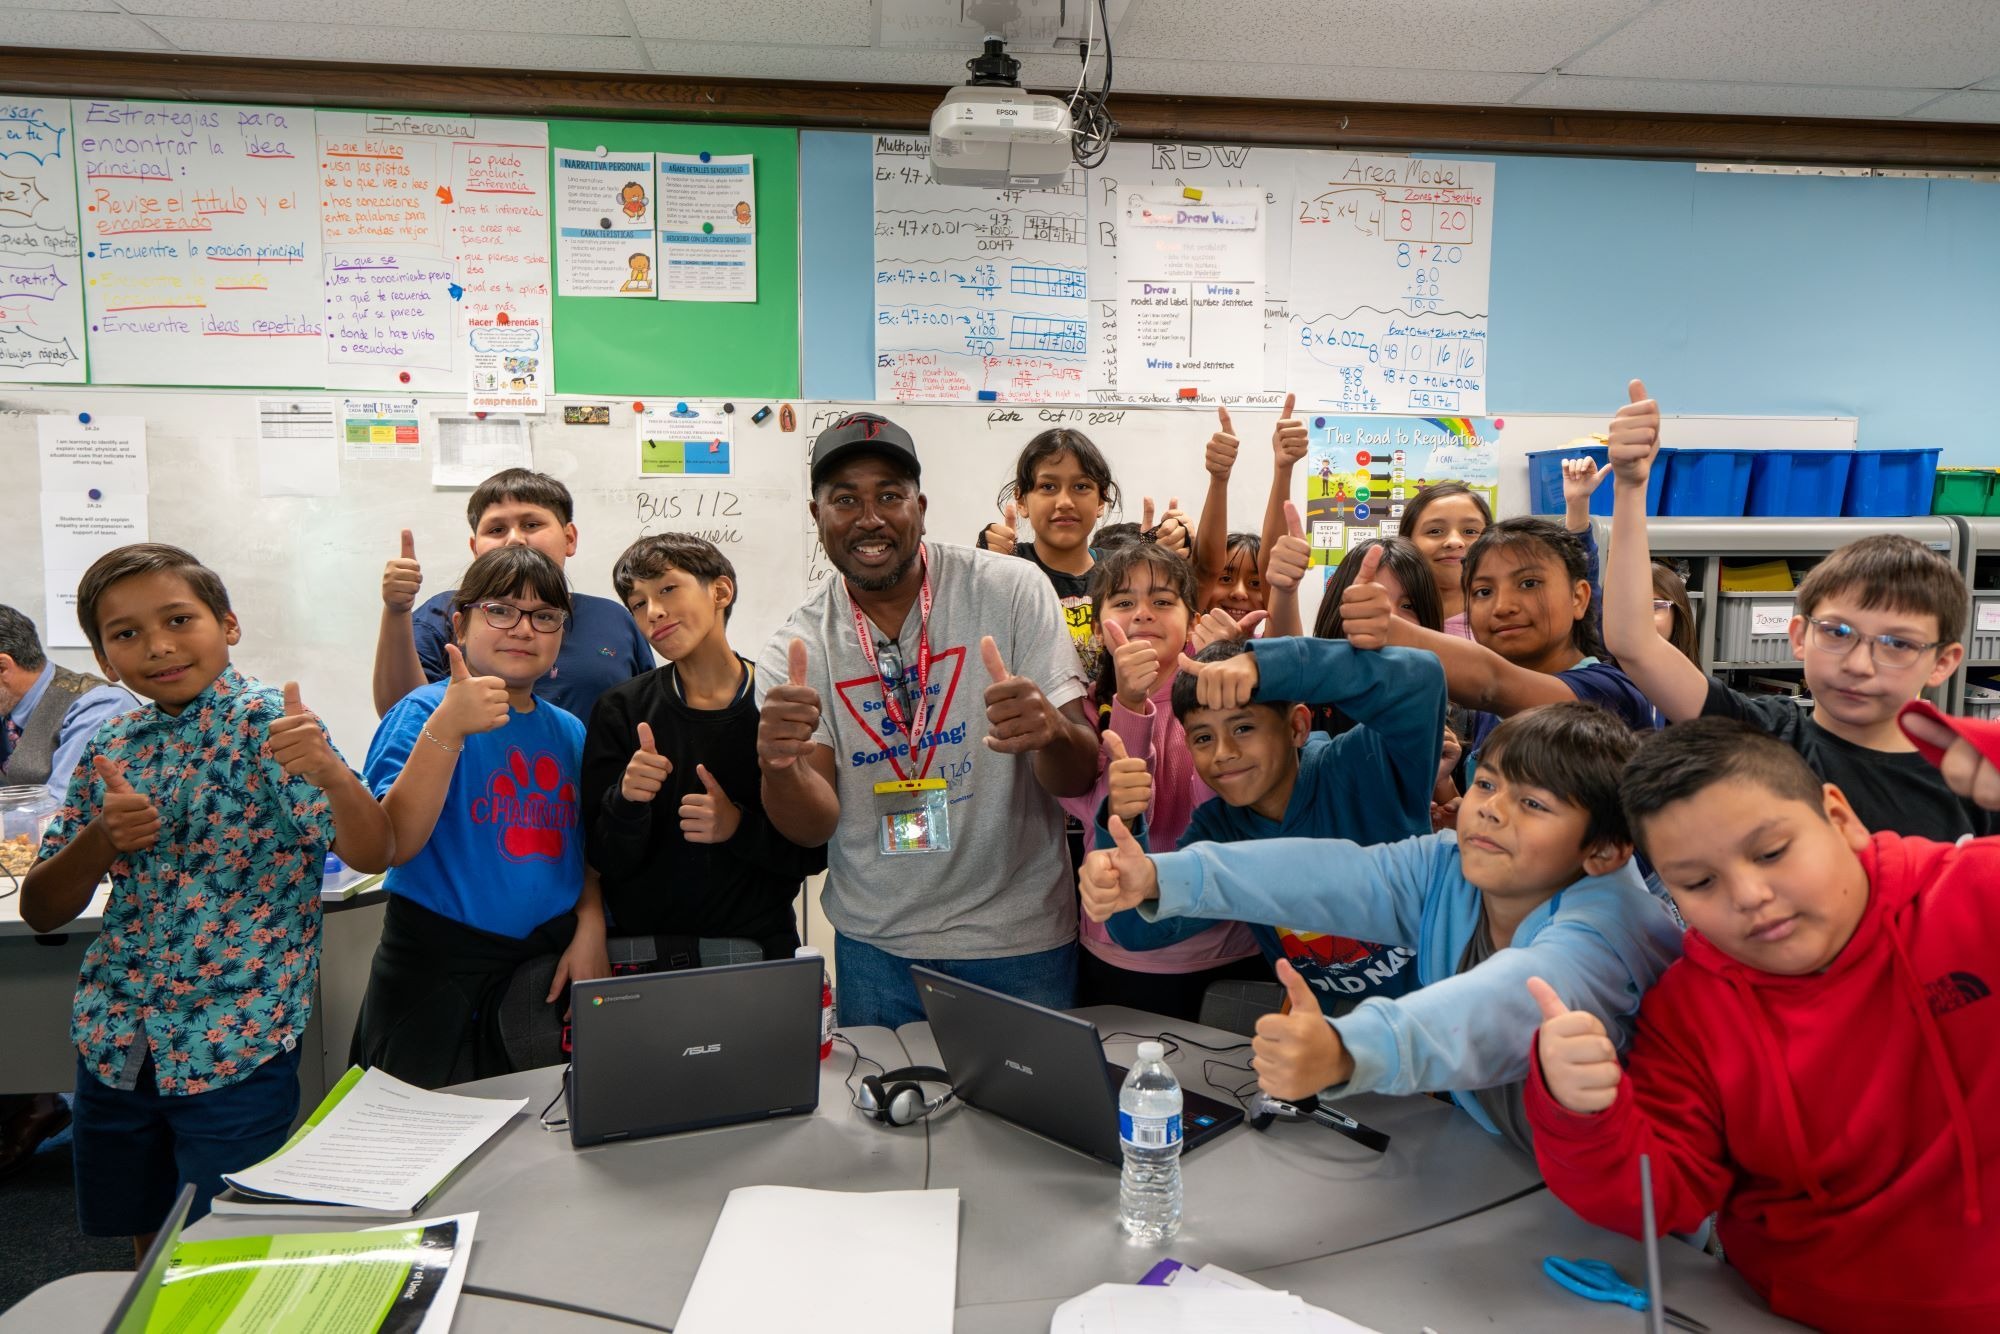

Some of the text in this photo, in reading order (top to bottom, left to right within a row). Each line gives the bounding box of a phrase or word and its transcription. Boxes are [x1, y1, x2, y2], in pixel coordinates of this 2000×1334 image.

[86, 103, 288, 136] Estrategias para
[375, 117, 470, 137] Inferencia
[82, 136, 292, 154] encontrar la idea
[488, 152, 521, 169] puedo
[565, 159, 645, 172] NARRATIVA PERSONAL
[1152, 144, 1252, 170] RDW
[88, 161, 171, 184] principal
[375, 162, 410, 176] pistas
[1343, 158, 1461, 189] Area Model
[95, 188, 296, 215] Revise el y el
[1177, 210, 1209, 224] Draw
[99, 242, 179, 259] Encuentre
[256, 242, 305, 265] principal
[335, 256, 349, 267] Lo
[354, 257, 373, 270] que
[1144, 284, 1169, 295] Draw
[1207, 285, 1233, 295] Write
[1131, 297, 1168, 306] model and
[1222, 298, 1253, 307] sentence
[102, 313, 321, 338] Encuentre ideas repetidas
[469, 318, 493, 326] Hacer
[1146, 358, 1173, 369] Write
[1182, 361, 1201, 369] word
[1203, 361, 1235, 369] sentence
[473, 396, 538, 406] comprensión
[1038, 409, 1065, 422] Oct
[1089, 410, 1126, 427] 2024
[1325, 427, 1487, 453] The Road to Regulation
[636, 491, 682, 523] BUS
[604, 994, 640, 1003] chromebook
[682, 1043, 721, 1056] ASUS
[1004, 1059, 1034, 1076] ASUS
